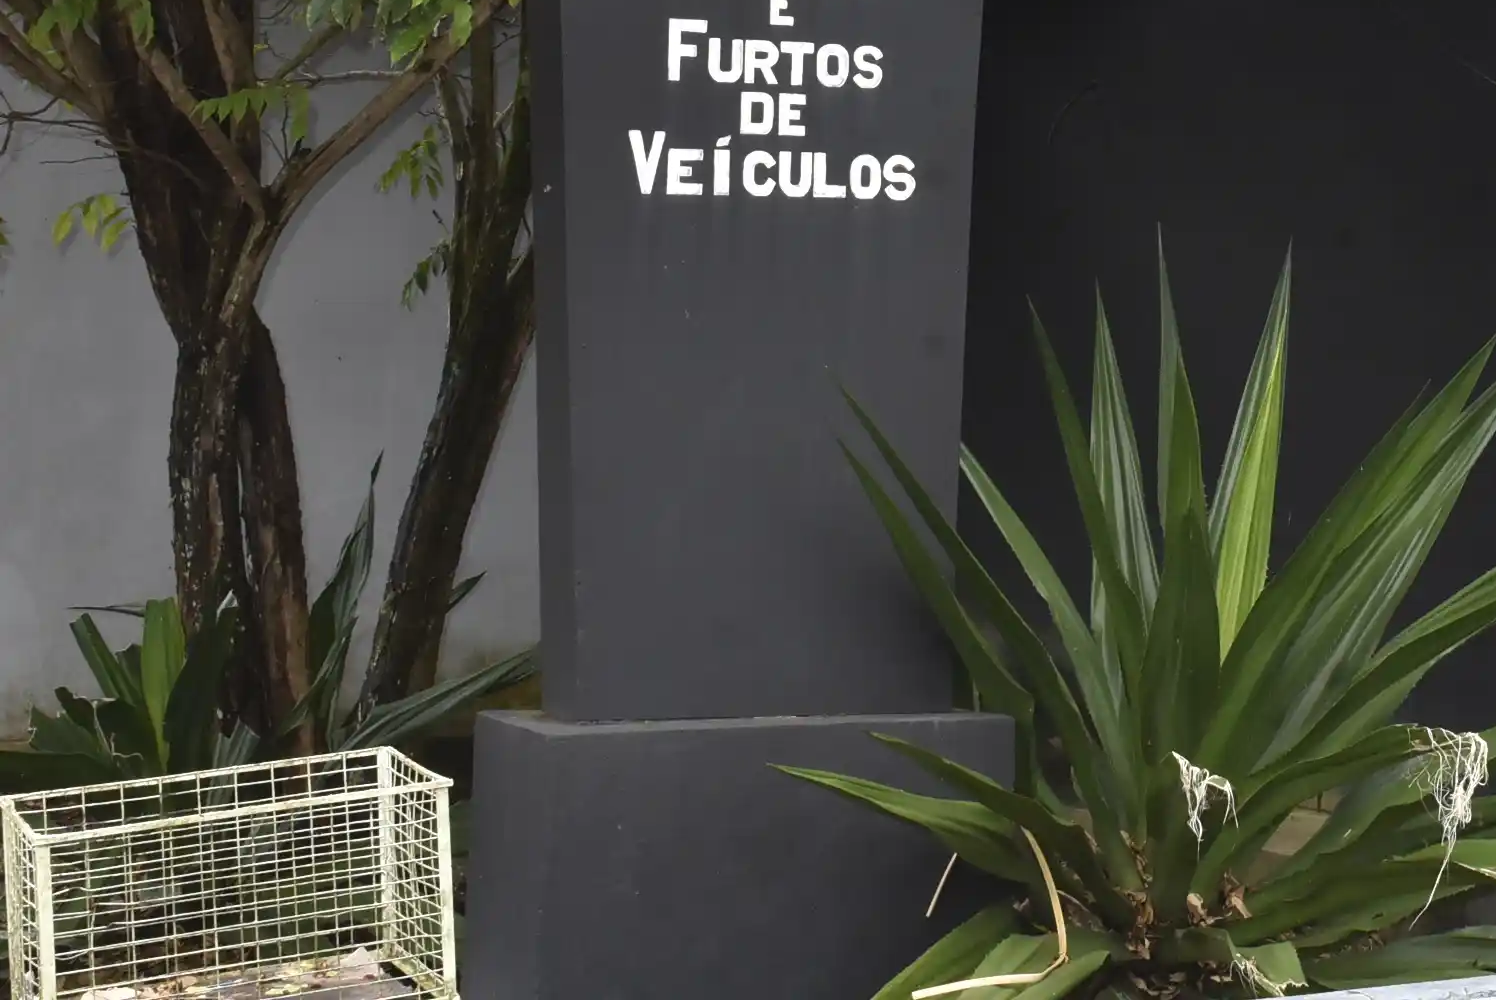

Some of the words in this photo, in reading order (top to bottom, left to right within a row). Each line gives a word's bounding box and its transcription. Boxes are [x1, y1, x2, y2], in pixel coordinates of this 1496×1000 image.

[667, 17, 884, 89] FURTOS
[739, 91, 807, 137] DE
[628, 130, 917, 202] VEÍCULOS
